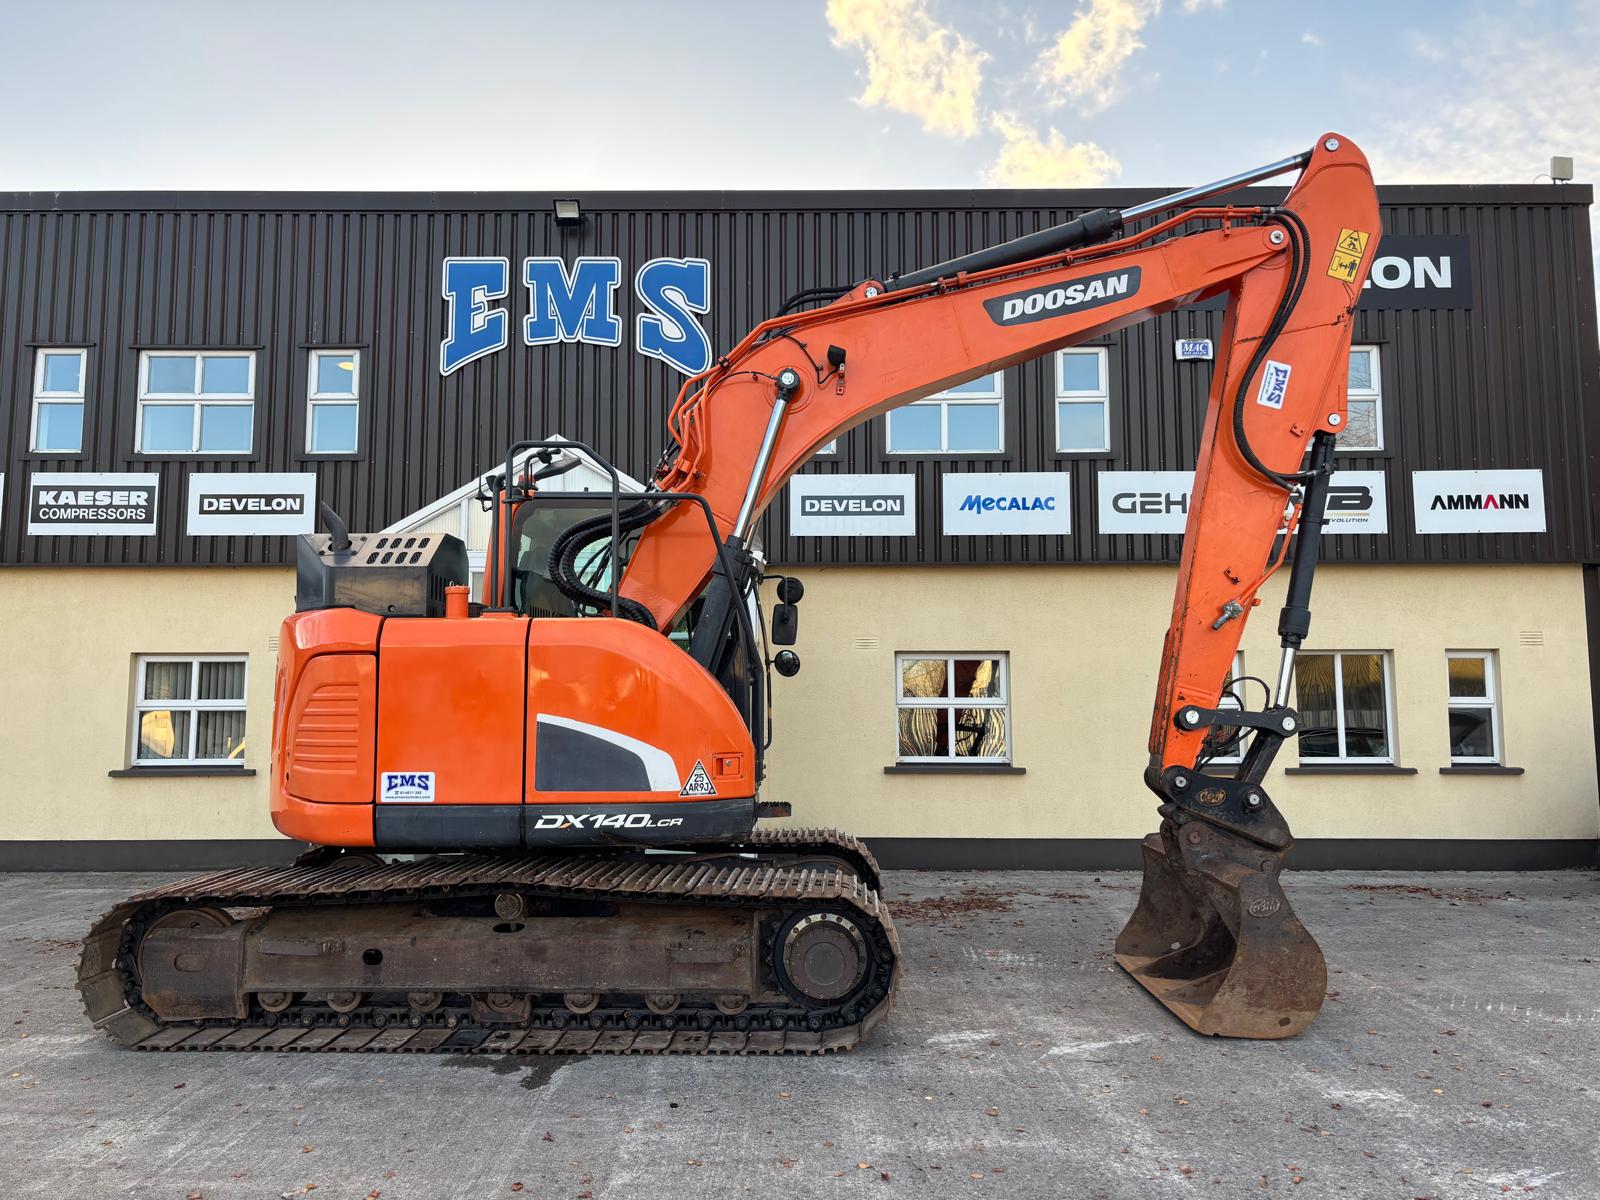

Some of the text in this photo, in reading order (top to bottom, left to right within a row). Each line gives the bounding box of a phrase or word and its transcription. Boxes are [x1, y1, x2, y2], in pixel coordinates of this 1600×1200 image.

[1362, 256, 1452, 289] ON
[1003, 274, 1128, 320] DOOSAN
[440, 256, 712, 377] EMS
[1183, 343, 1208, 352] MAC
[1267, 366, 1288, 404] EMS
[38, 490, 149, 506] KAESER
[203, 498, 300, 511] DEVELON
[805, 499, 901, 512] DEVELON
[1112, 492, 1191, 514] GEH
[1430, 494, 1530, 510] AMMANN
[39, 508, 146, 520] COMPRESSORS
[387, 775, 429, 792] EMS
[694, 774, 705, 782] 25
[688, 782, 710, 792] AR9J
